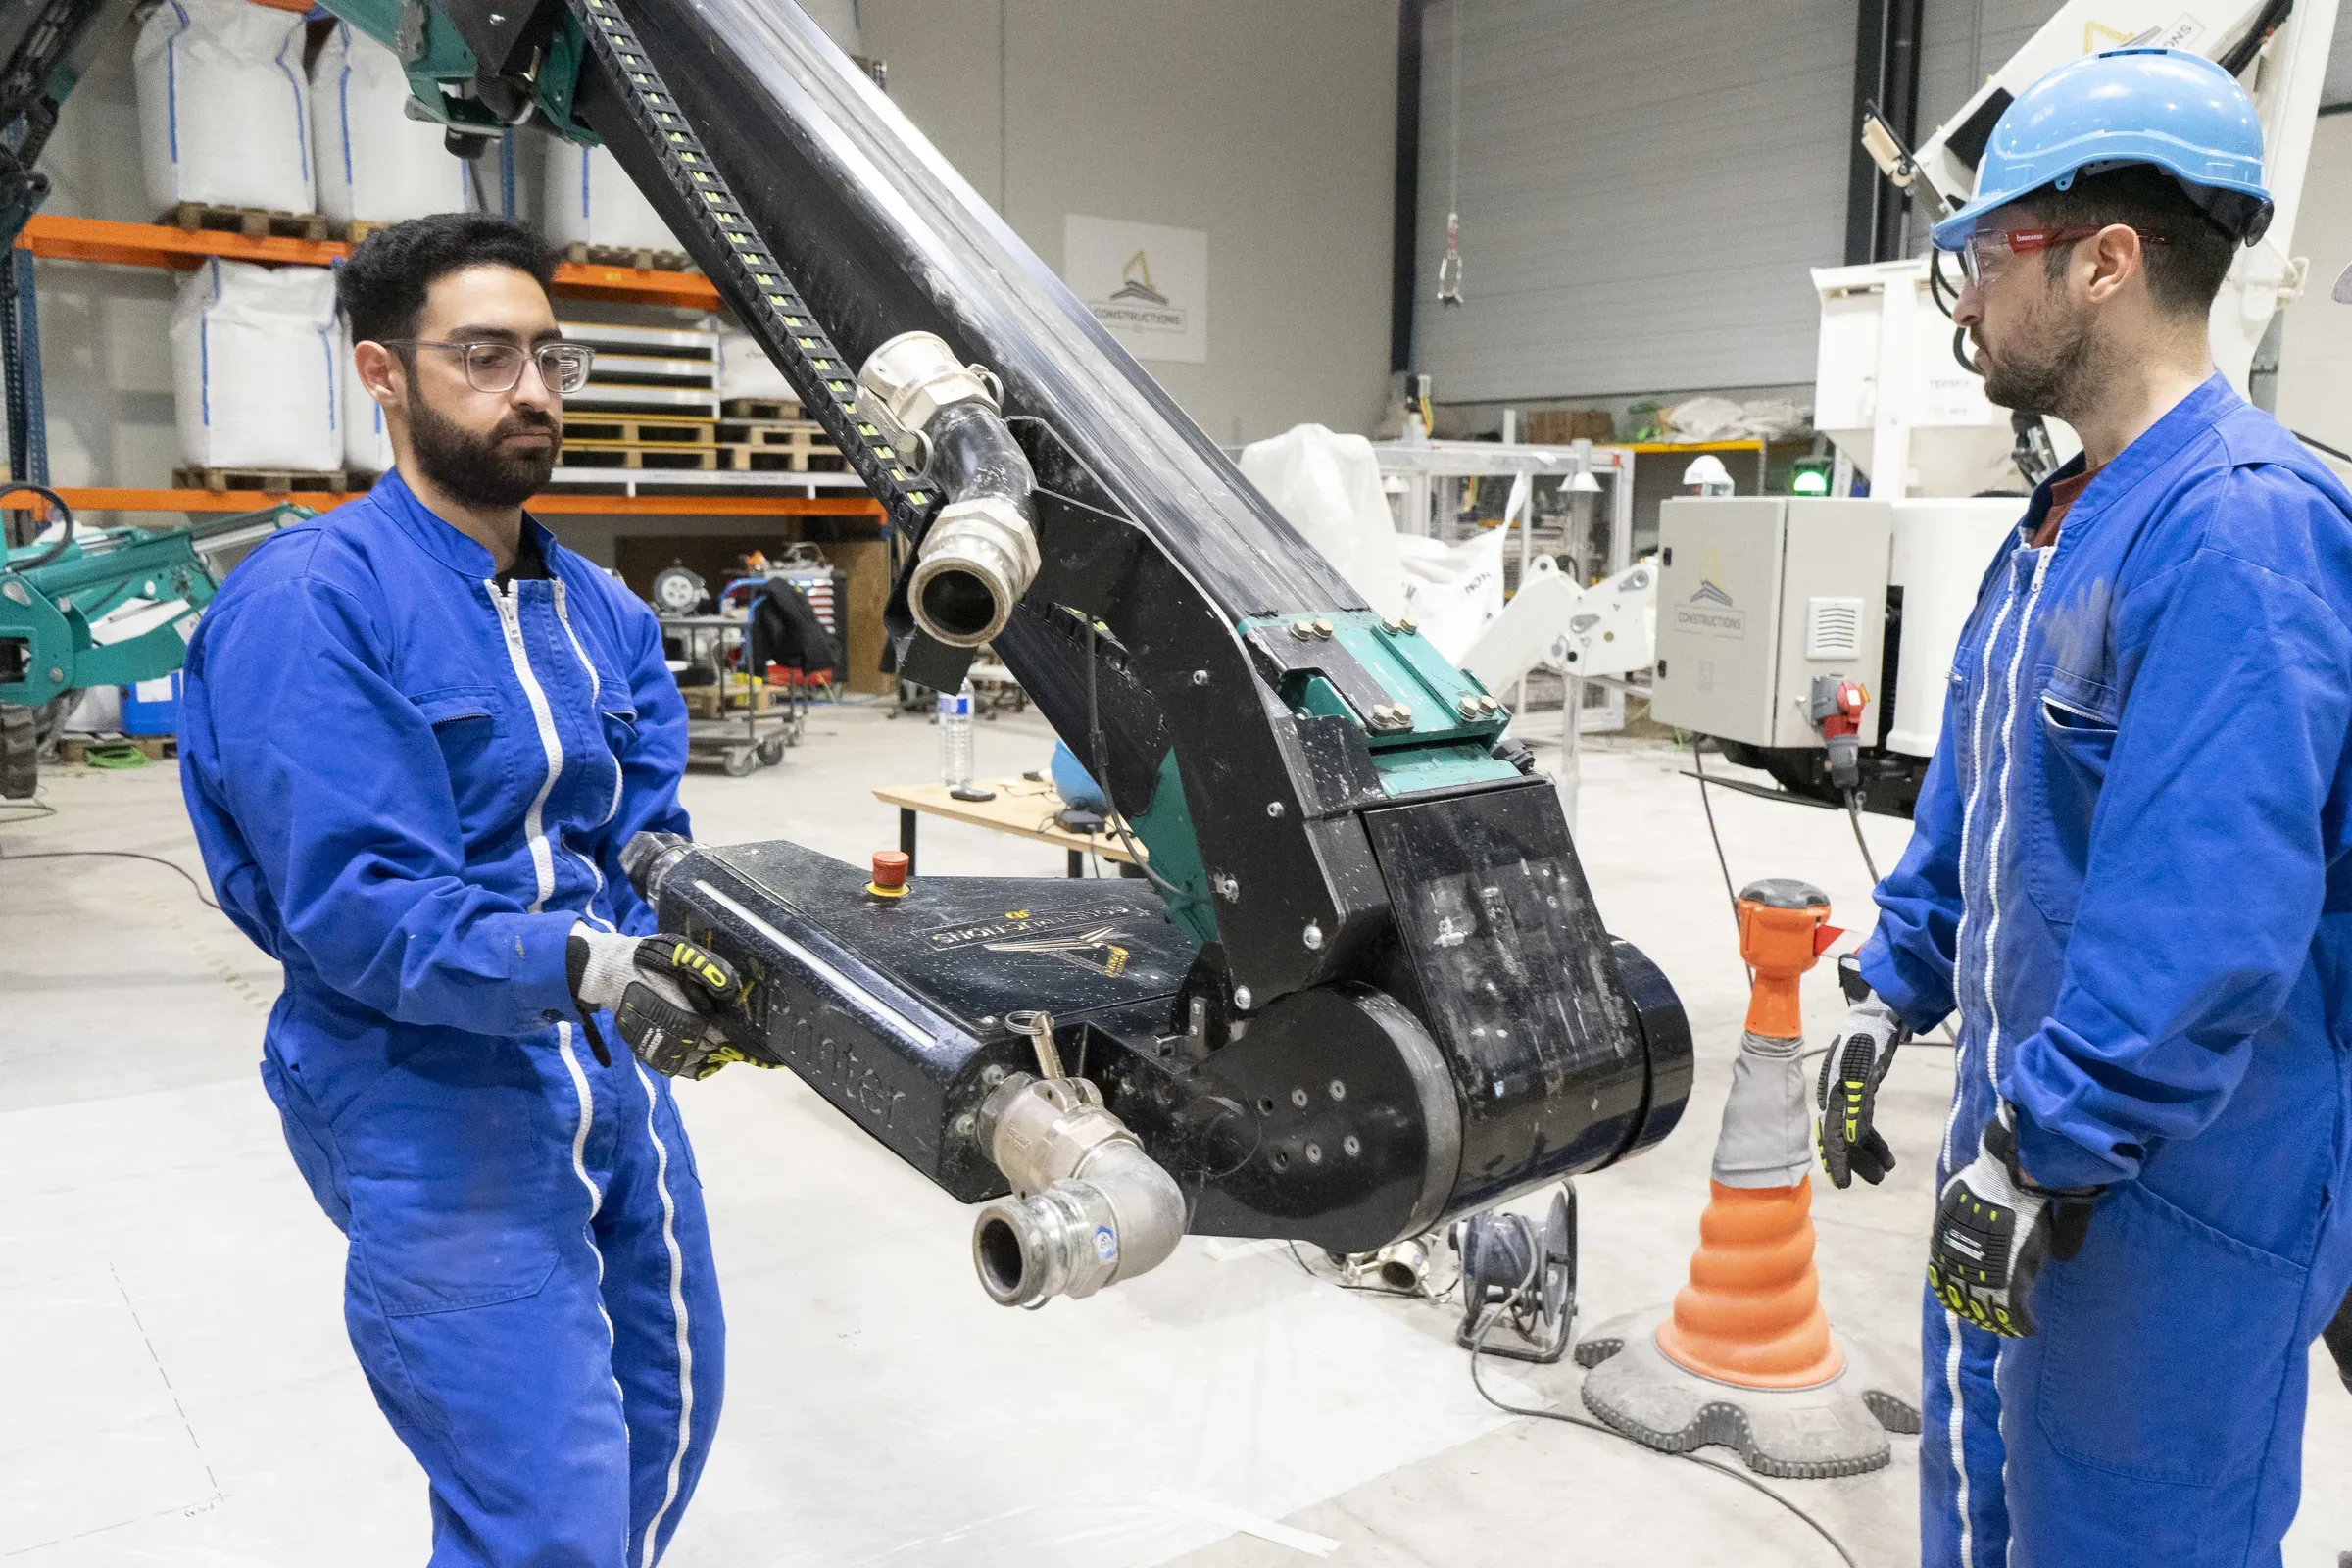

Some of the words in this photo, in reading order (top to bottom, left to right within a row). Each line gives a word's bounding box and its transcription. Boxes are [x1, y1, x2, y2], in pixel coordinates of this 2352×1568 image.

[1095, 309, 1180, 325] CONSTRUCTIONS
[1677, 611, 1742, 630] CONSTRUCTIONS
[932, 906, 1129, 944] CONSTRUCTIONS
